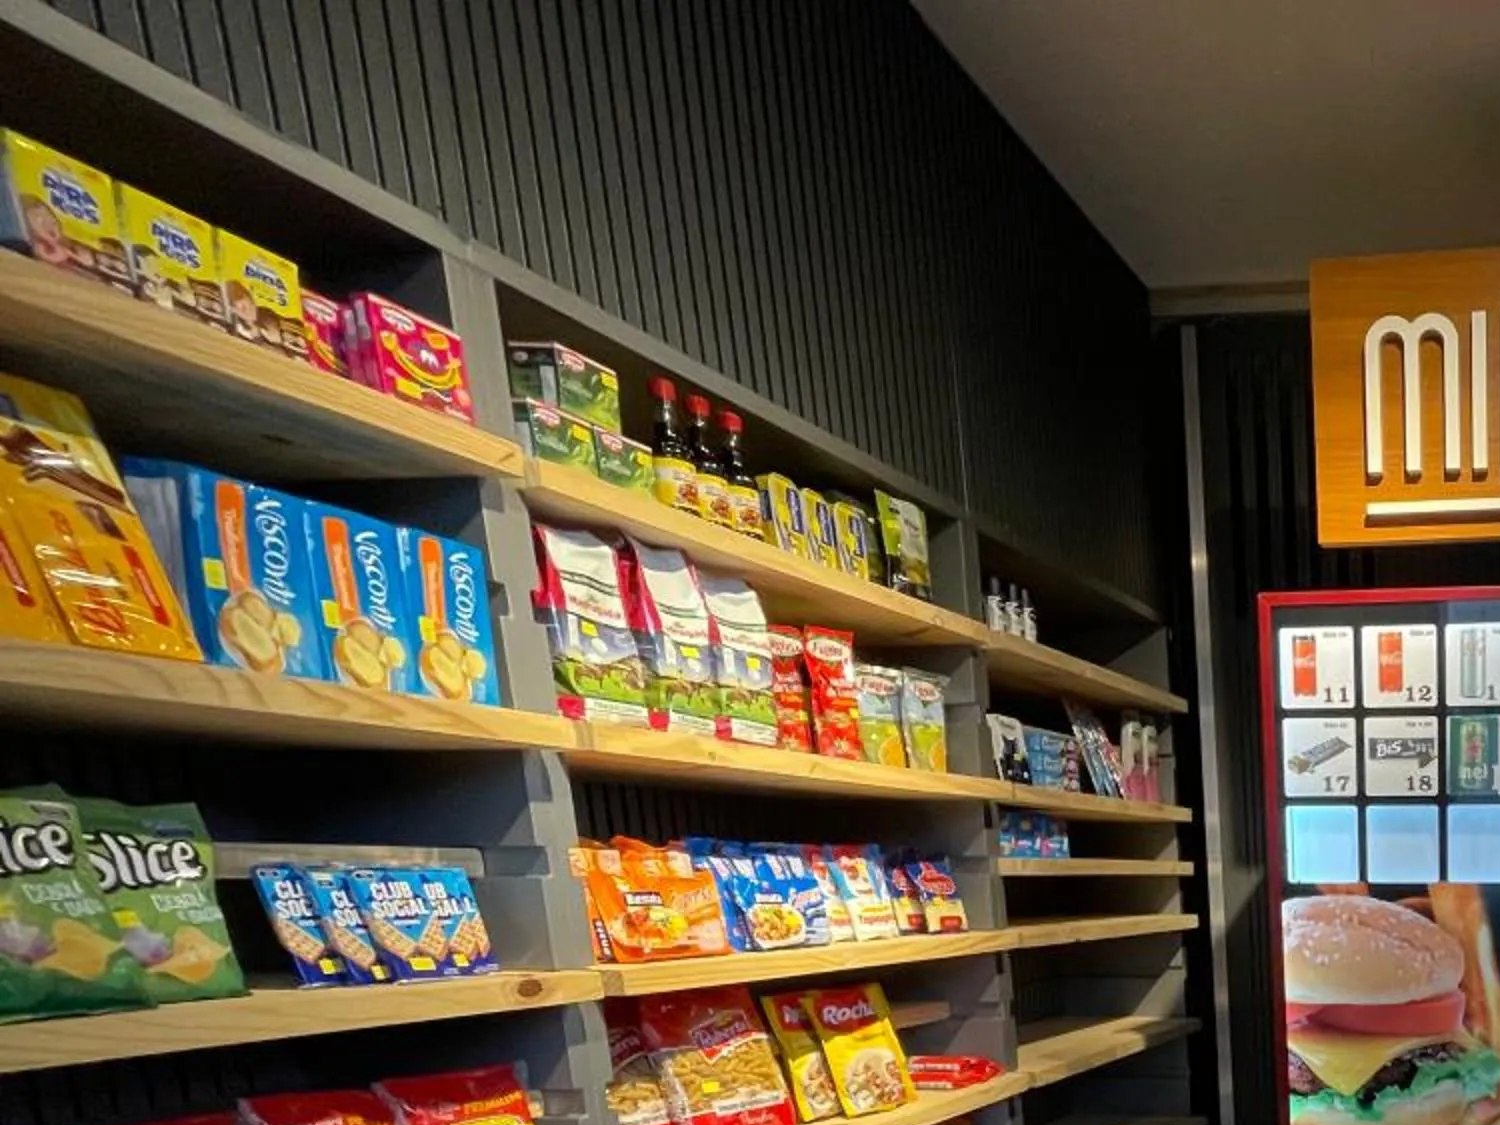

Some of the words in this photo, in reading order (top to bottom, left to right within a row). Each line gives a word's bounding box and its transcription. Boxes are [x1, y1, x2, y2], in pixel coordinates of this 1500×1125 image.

[1324, 687, 1349, 703] 11
[1406, 685, 1433, 701] 12
[1324, 775, 1350, 792] 17
[1407, 775, 1433, 792] 18
[0, 820, 75, 874] ice
[370, 880, 413, 900] CLUB
